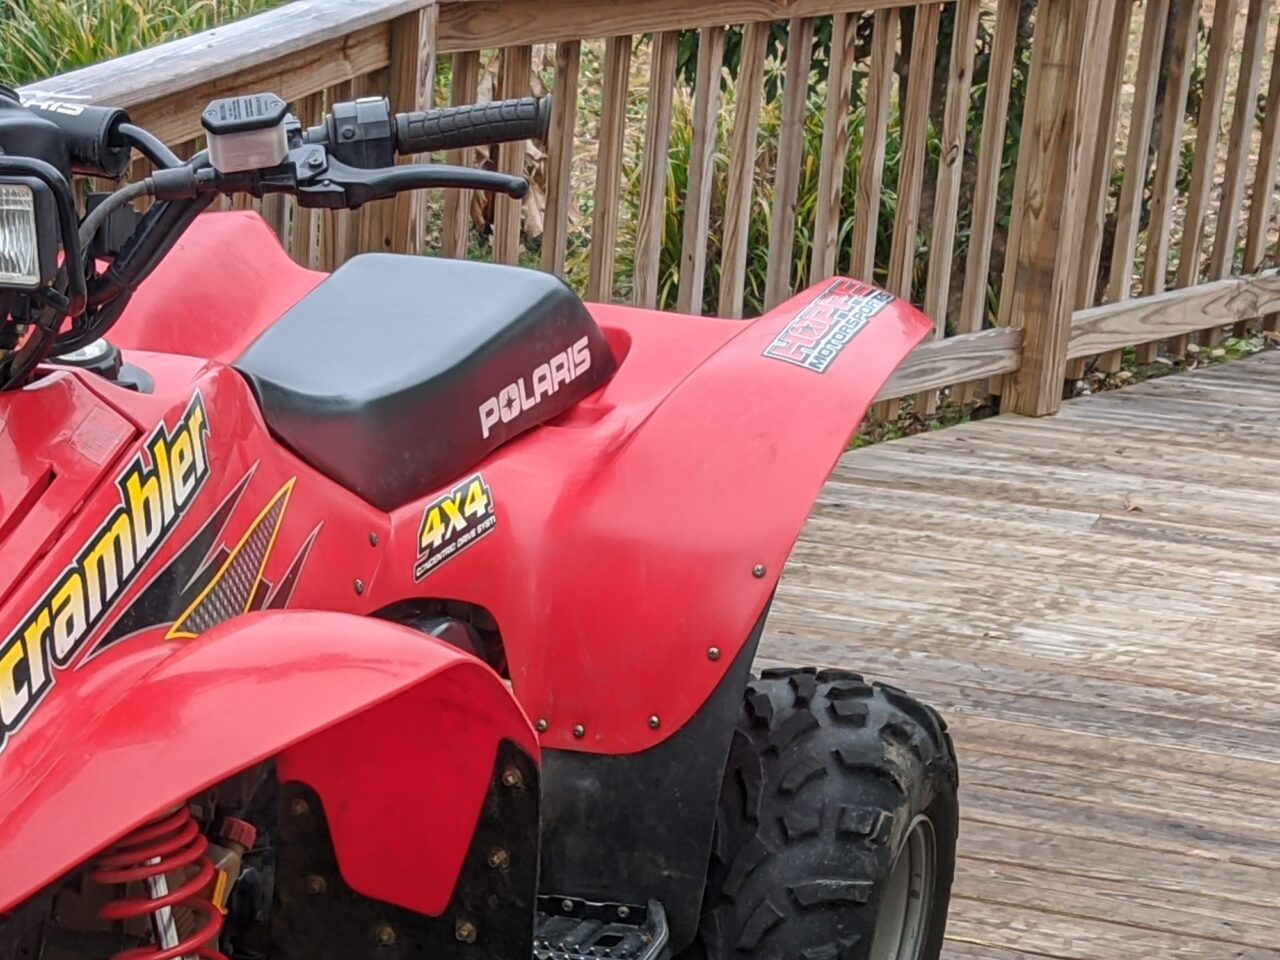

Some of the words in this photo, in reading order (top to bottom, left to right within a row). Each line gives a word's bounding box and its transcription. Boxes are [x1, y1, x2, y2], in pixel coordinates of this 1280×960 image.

[479, 336, 591, 439] POLARIS
[421, 480, 488, 548] 4X4
[457, 528, 476, 547] DRIVE
